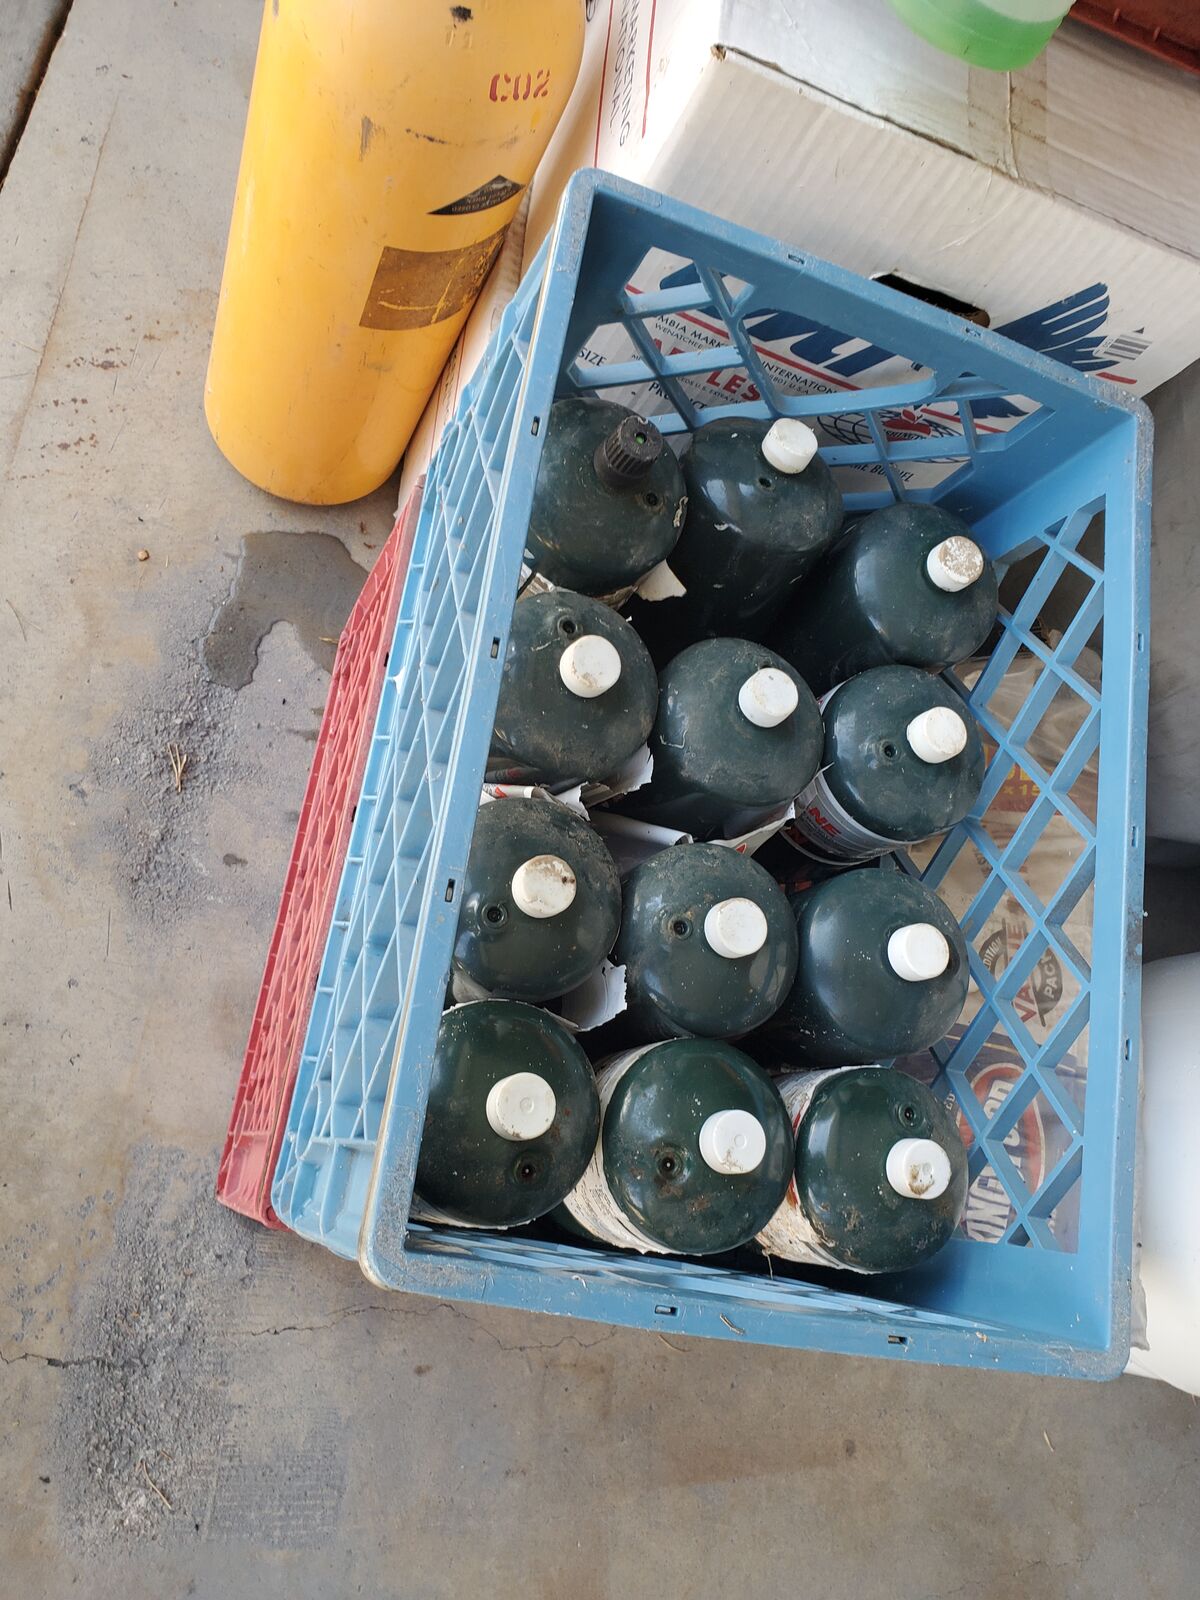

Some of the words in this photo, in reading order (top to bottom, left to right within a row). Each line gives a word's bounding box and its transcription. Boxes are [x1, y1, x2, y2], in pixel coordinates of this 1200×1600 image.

[578, 346, 608, 367] SIZE
[656, 314, 688, 335] MBIA
[691, 328, 726, 349] MARK
[761, 360, 838, 395] INTERNATION
